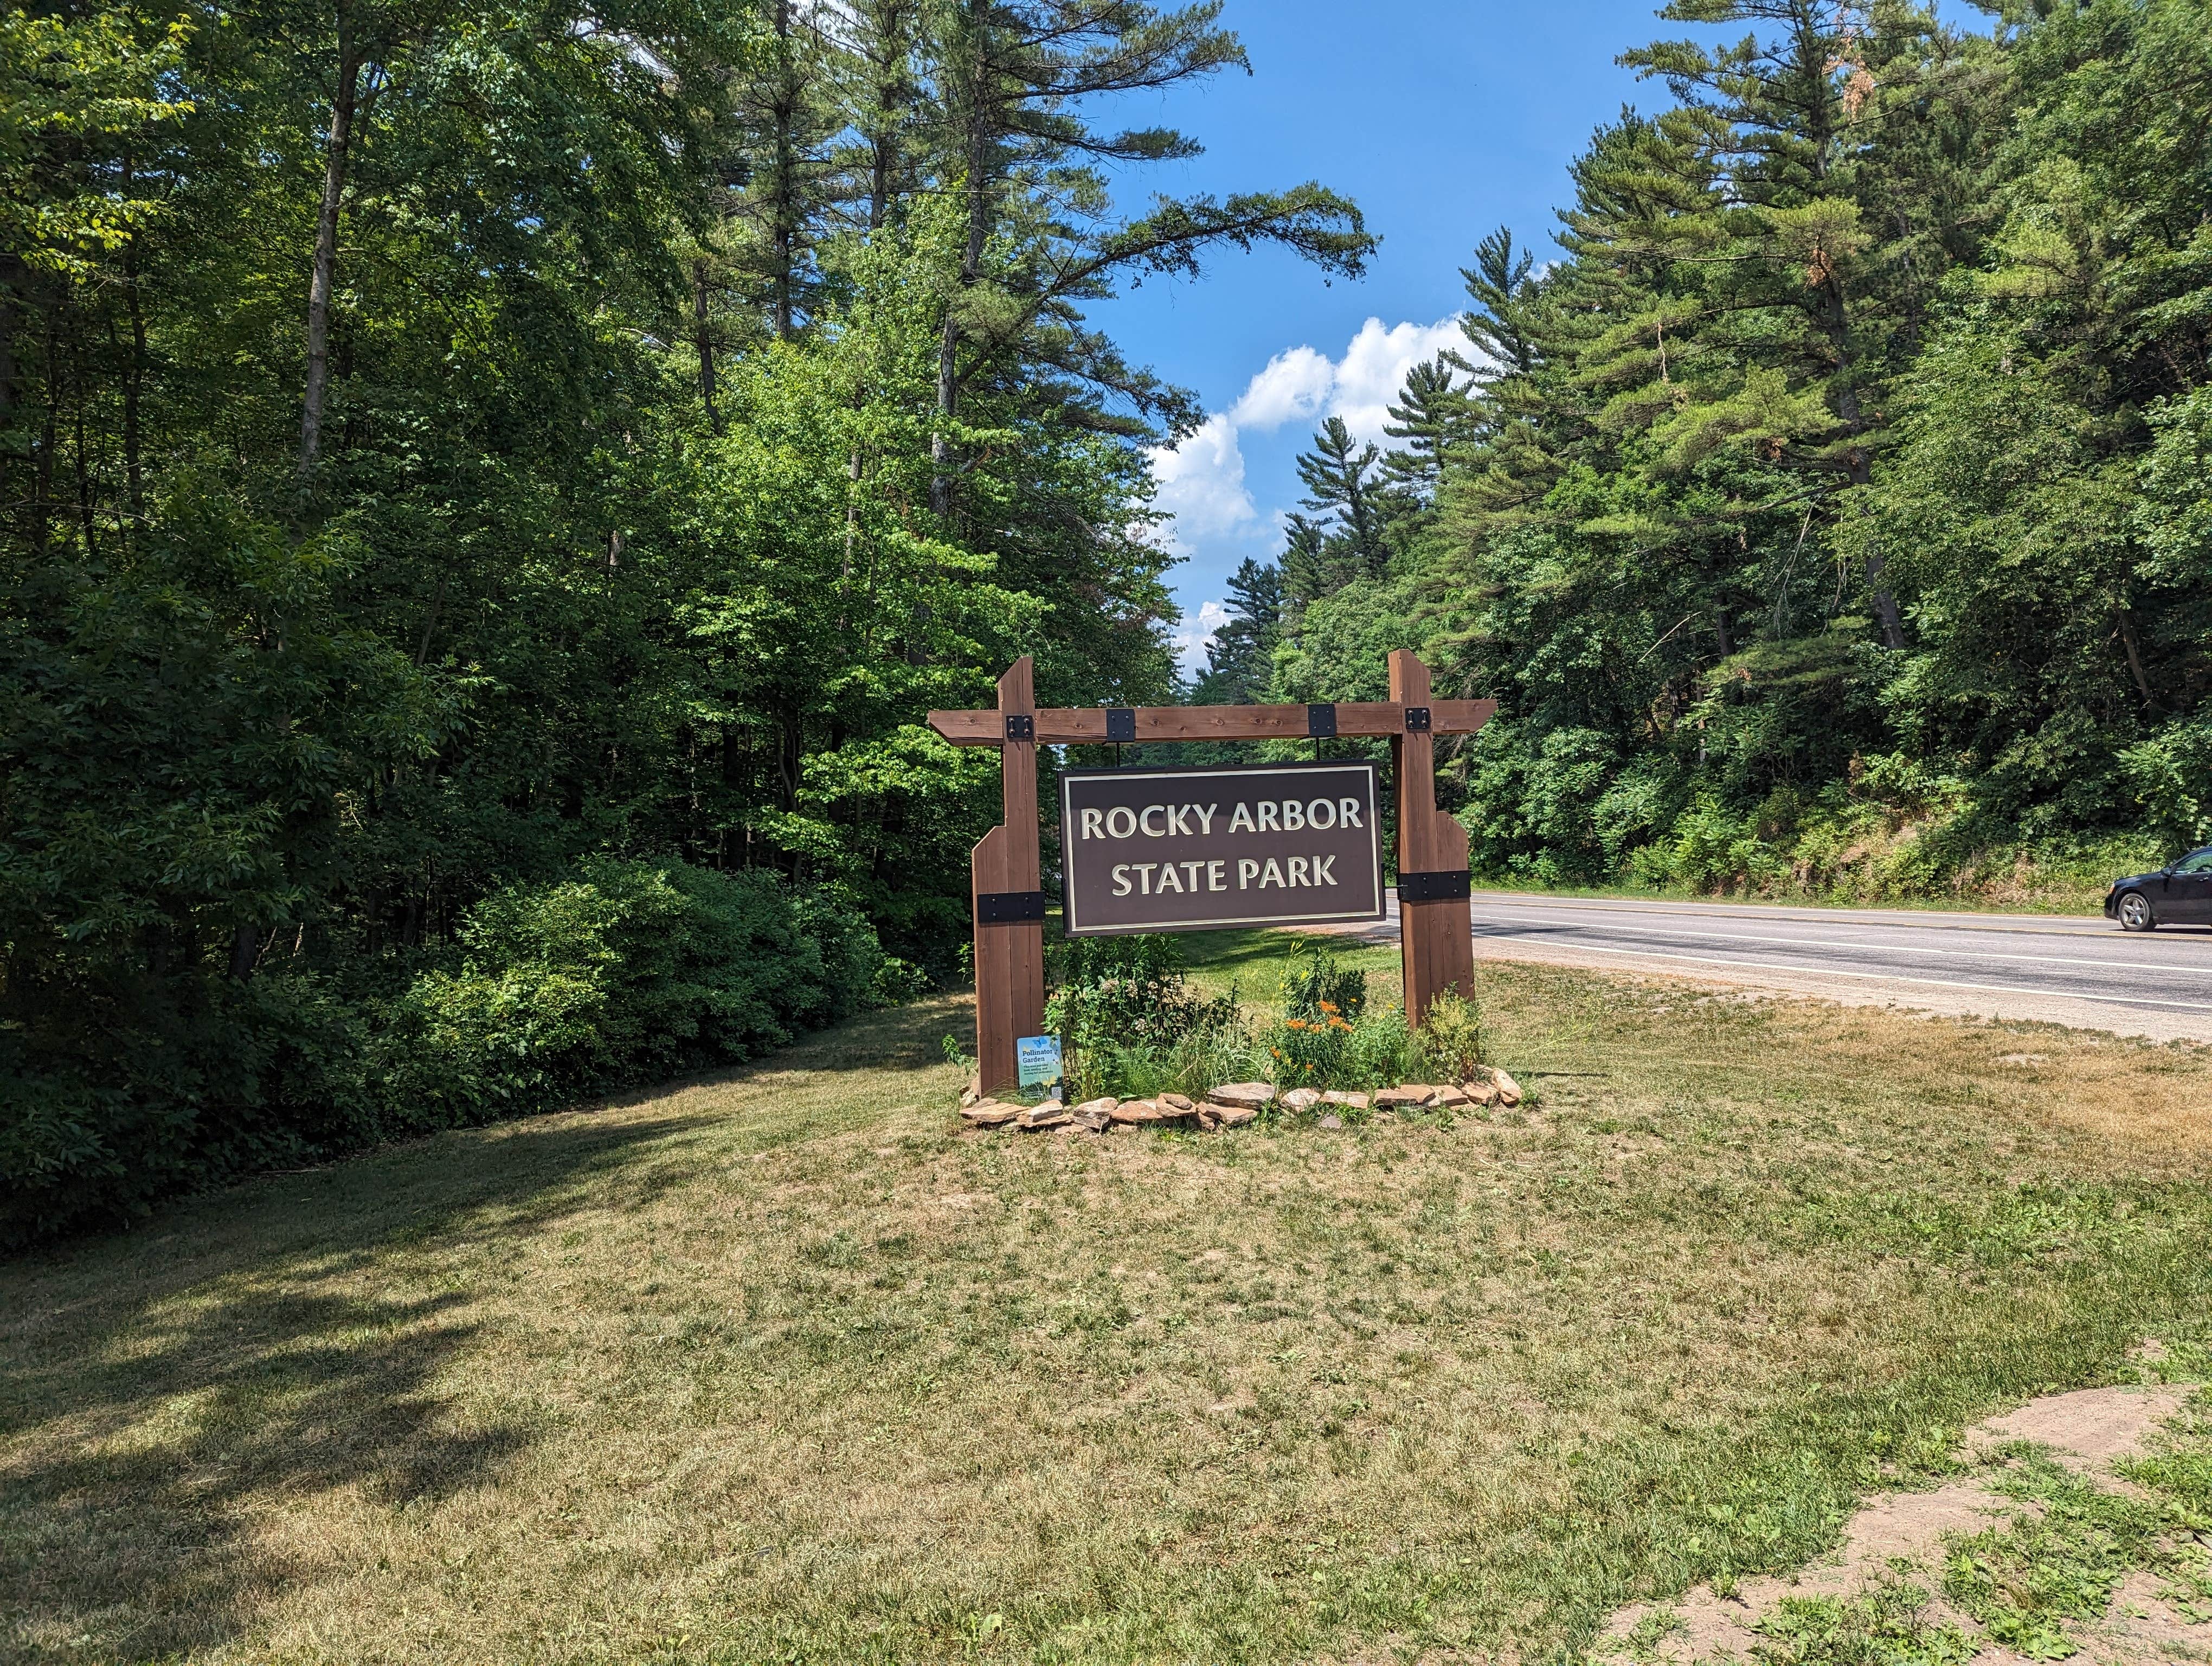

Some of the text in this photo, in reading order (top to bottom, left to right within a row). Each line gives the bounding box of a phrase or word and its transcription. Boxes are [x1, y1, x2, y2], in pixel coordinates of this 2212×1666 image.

[1081, 797, 1364, 840] ROCKY ARBOR
[1111, 854, 1338, 896] STATE PARK
